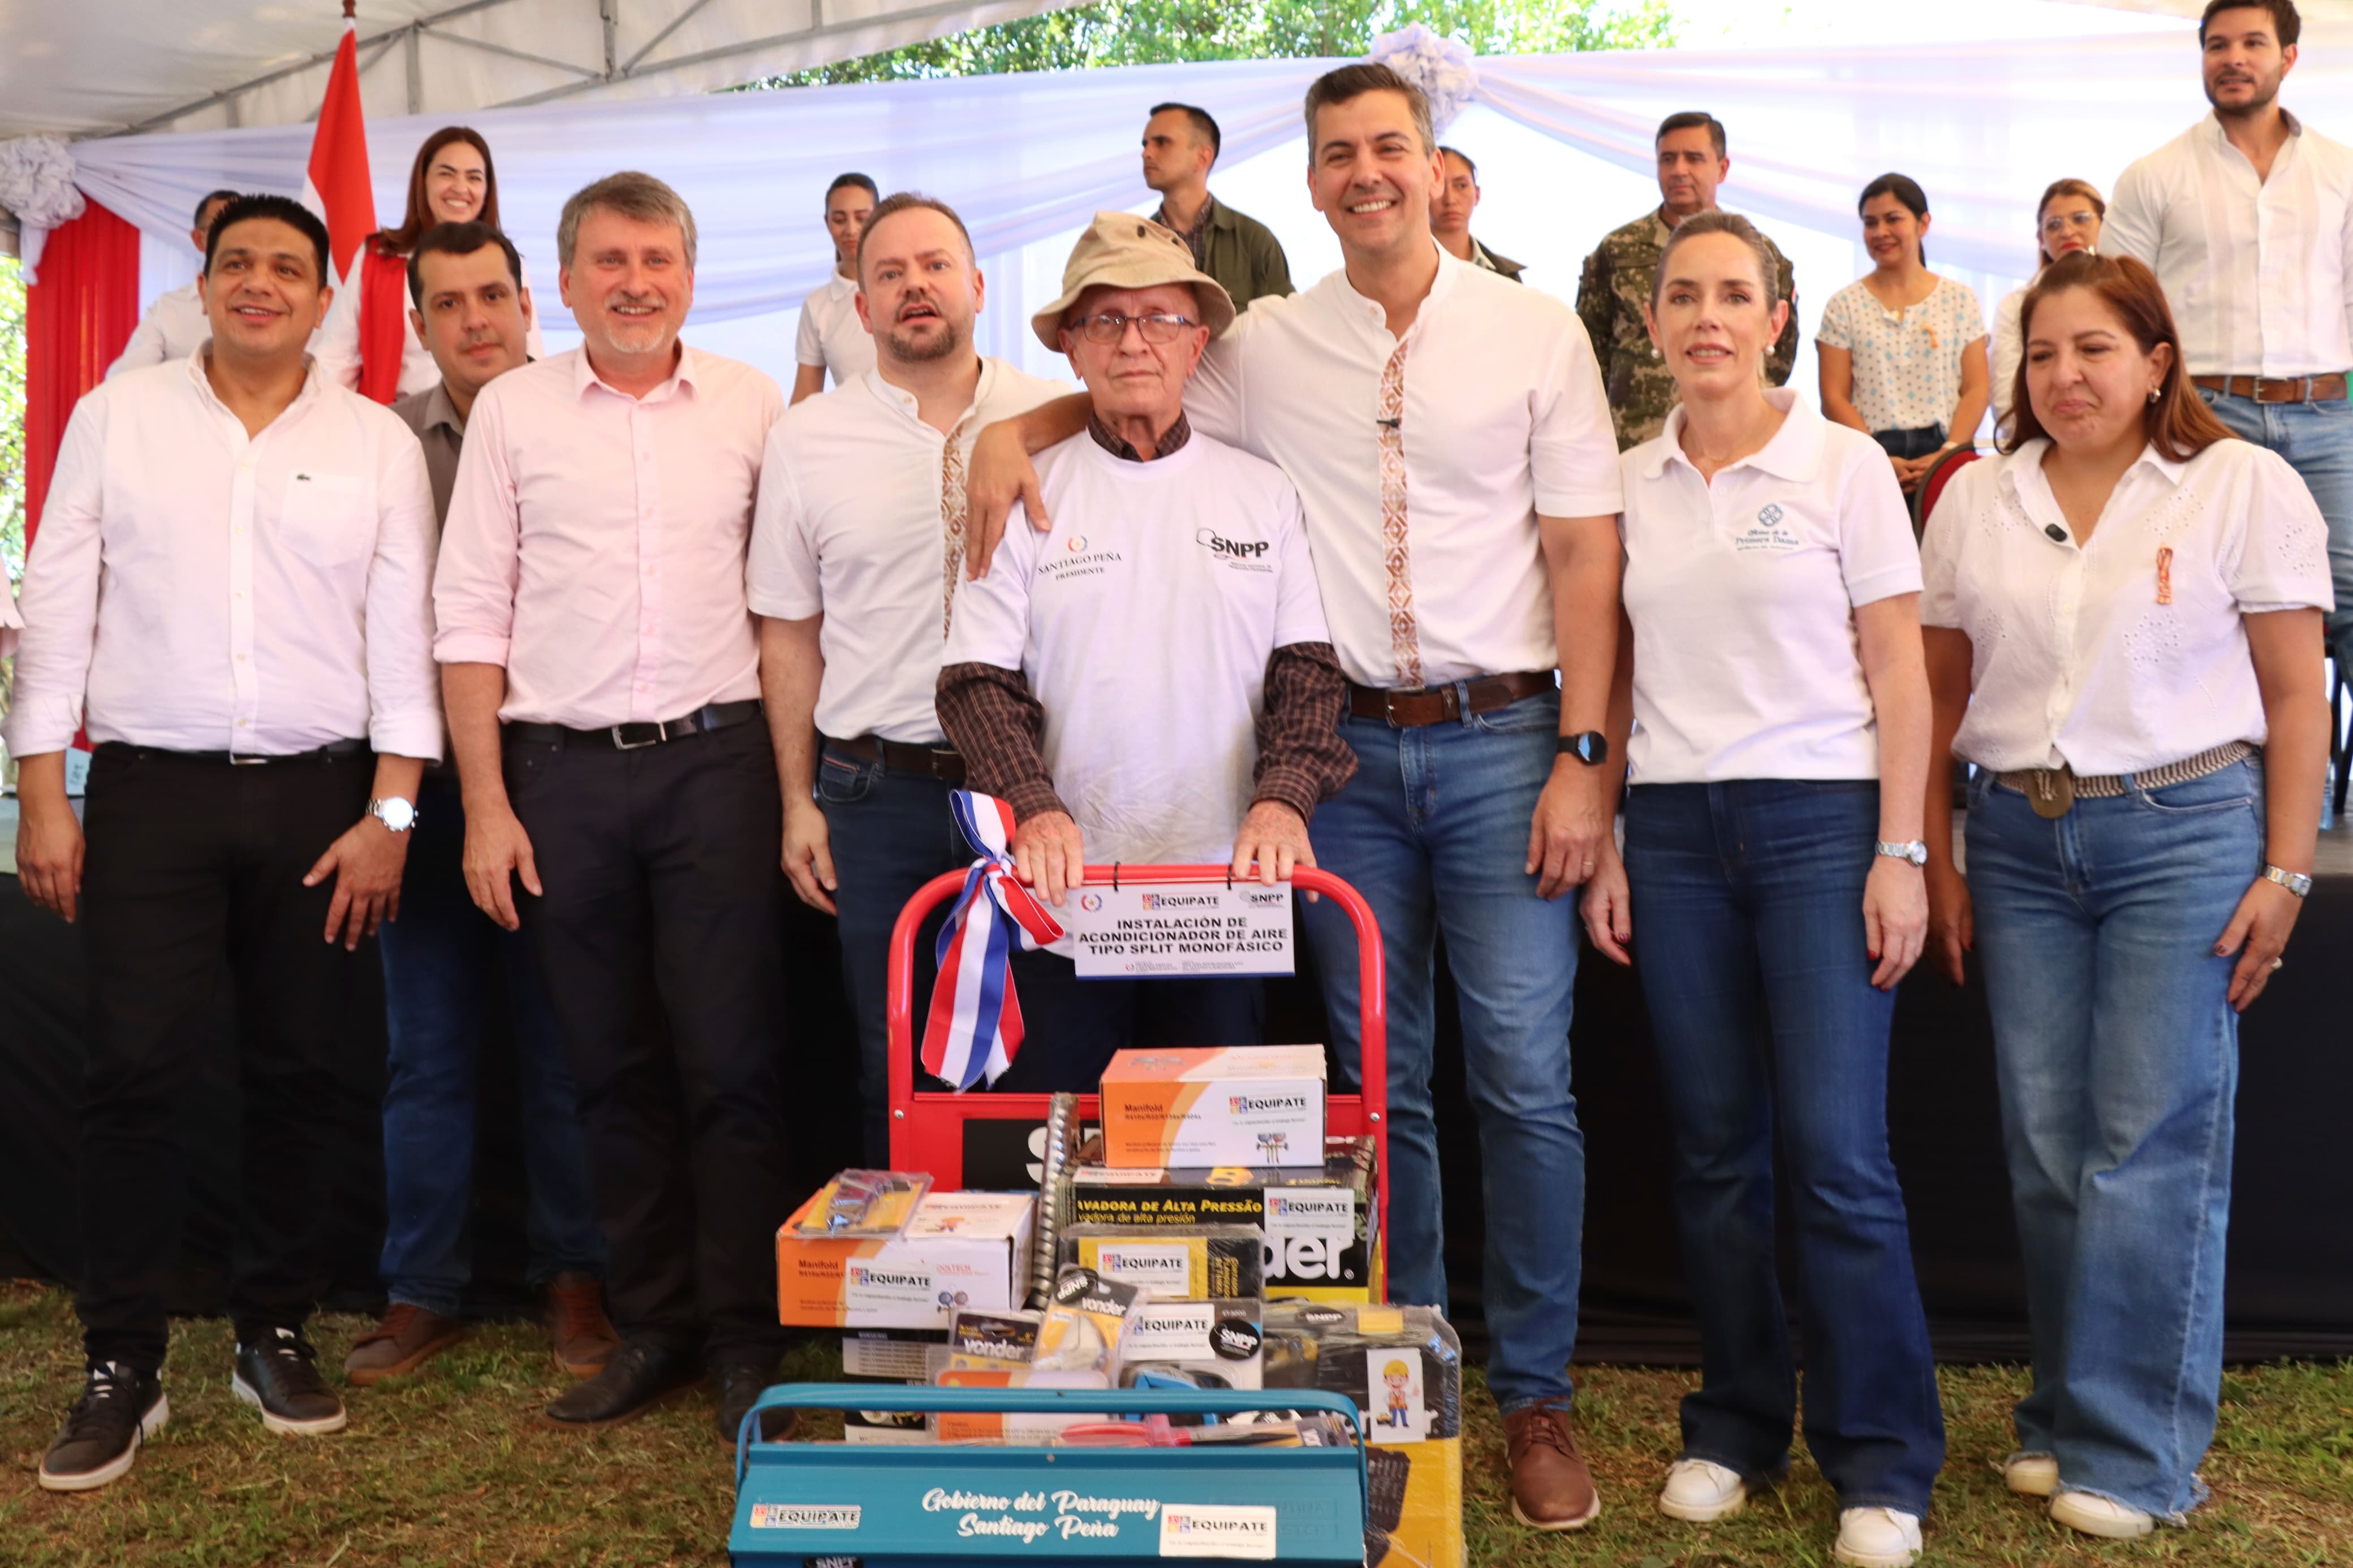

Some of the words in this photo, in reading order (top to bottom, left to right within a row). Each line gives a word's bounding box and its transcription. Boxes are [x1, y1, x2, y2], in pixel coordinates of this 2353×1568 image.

[1211, 537, 1269, 558] SNPP
[1038, 555, 1091, 574] SANTIAGO
[1094, 551, 1122, 561] PEÑA
[1055, 567, 1105, 581] PRESIDENTE
[1161, 895, 1219, 906] EQUIPATE
[1251, 893, 1283, 902] SNPP
[1118, 915, 1222, 930] INSTALACIÓN
[1227, 917, 1247, 927] DE
[1080, 930, 1221, 943] ACONDICIONADOR
[1226, 930, 1246, 940] DE
[1252, 928, 1287, 939] AIRE
[1089, 944, 1124, 954] TIPO
[1130, 944, 1173, 954] SPLIT
[1179, 940, 1283, 954] MONOFÁSICO
[1124, 1104, 1163, 1112] Manifold
[1248, 1097, 1307, 1109] EQUIPATE
[1141, 1201, 1160, 1211] DE
[1163, 1199, 1196, 1212] ALTA
[1200, 1199, 1262, 1213] PRESSÃO
[1289, 1202, 1348, 1213] EQUIPATE
[1118, 1212, 1131, 1223] de
[1134, 1212, 1153, 1223] alta
[1156, 1212, 1196, 1225] presión
[799, 1259, 838, 1269] Manifold
[1123, 1258, 1182, 1269] EQUIPATE
[870, 1273, 931, 1286] EQUIPATE
[1057, 1276, 1088, 1300] SNPP
[1082, 1297, 1127, 1316] vonder
[1144, 1319, 1208, 1331] EQUIPATE
[1221, 1328, 1258, 1348] SNPP
[964, 1338, 1025, 1359] vonder
[922, 1488, 1011, 1511] Gobierno
[1014, 1491, 1046, 1511] del
[1050, 1490, 1161, 1520] Paraguay
[779, 1510, 858, 1523] EQUIPATE
[957, 1512, 1050, 1544] Santiago
[1054, 1515, 1119, 1540] Peña
[1192, 1521, 1268, 1531] EQUIPATE
